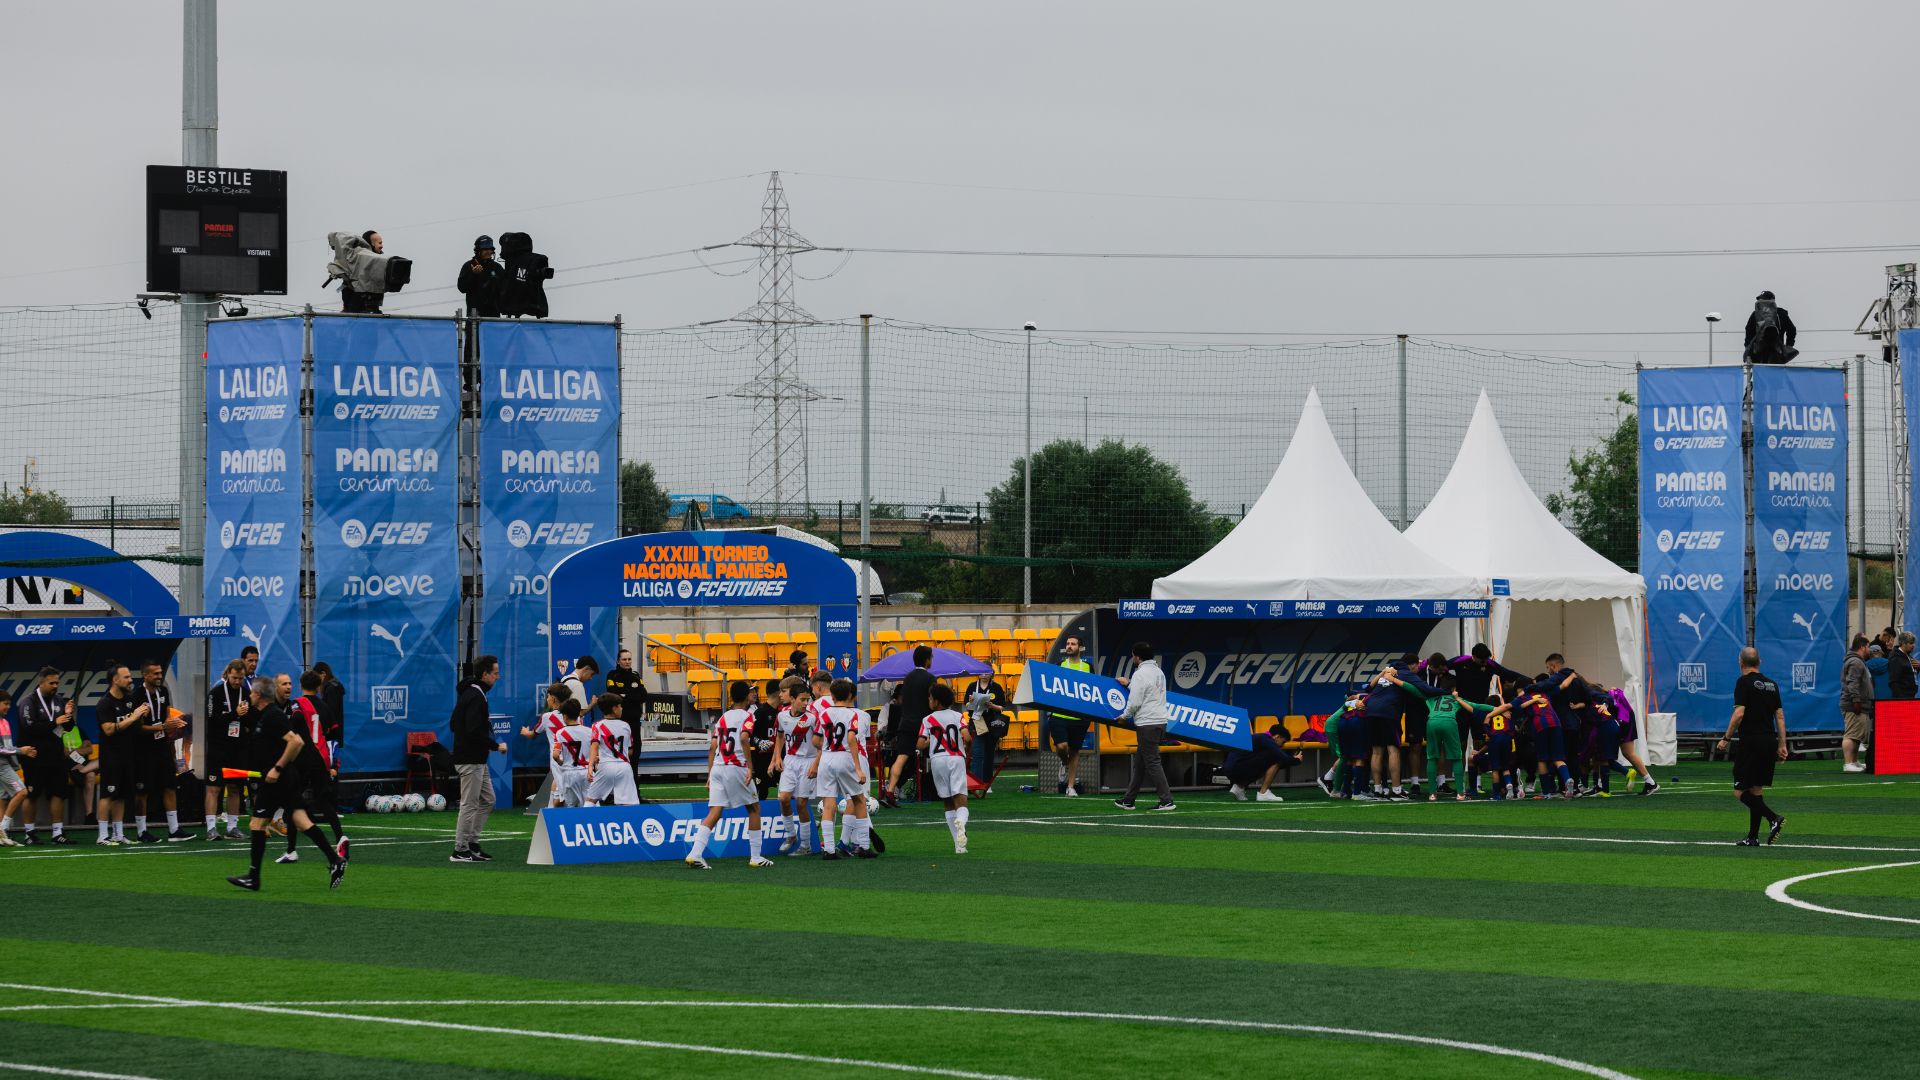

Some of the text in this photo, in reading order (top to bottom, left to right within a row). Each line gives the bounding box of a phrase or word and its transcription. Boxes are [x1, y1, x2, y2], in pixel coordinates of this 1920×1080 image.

[186, 169, 252, 186] BESTILE
[219, 366, 288, 399] LALIGA
[334, 365, 441, 397] LALIGA
[500, 368, 602, 401] LALIGA
[1653, 405, 1728, 432] LALIGA
[1766, 404, 1836, 432] LALIGA
[220, 448, 287, 474] PAMESA
[336, 447, 438, 472] PAMESA
[502, 450, 600, 474] PAMESA
[222, 476, 286, 494] cerámica
[340, 475, 435, 492] cerámica
[505, 476, 597, 493] cerámica
[1656, 471, 1727, 492] PAMESA
[1768, 472, 1835, 492] PAMESA
[1658, 493, 1725, 508] cerámica
[1771, 493, 1832, 508] cerámica
[346, 526, 362, 535] EA
[512, 526, 528, 536] EA
[644, 545, 769, 562] XXXIII TORNEO
[624, 562, 788, 580] NACIONAL PAMESA
[221, 576, 285, 597] moeve
[343, 574, 434, 596] moeve
[624, 582, 674, 598] LALIGA
[1657, 573, 1724, 592] moeve
[1775, 573, 1833, 592] moeve
[1122, 601, 1156, 611] PAMESA
[1295, 601, 1326, 610] PAMESA
[1376, 605, 1400, 613] moeve
[1457, 601, 1487, 610] PAMESA
[71, 624, 106, 634] moeve
[188, 617, 230, 628] PAMESA
[1180, 658, 1200, 672] EA
[377, 689, 404, 703] SOLAN
[1040, 674, 1104, 705] LALIGA
[653, 702, 675, 714] GRADA
[312, 714, 320, 744] 1
[1492, 714, 1505, 730] 8
[824, 722, 846, 751] 19
[930, 724, 960, 754] 20
[566, 740, 582, 767] 7
[559, 822, 639, 847] LALIGA
[646, 824, 660, 833] EA
